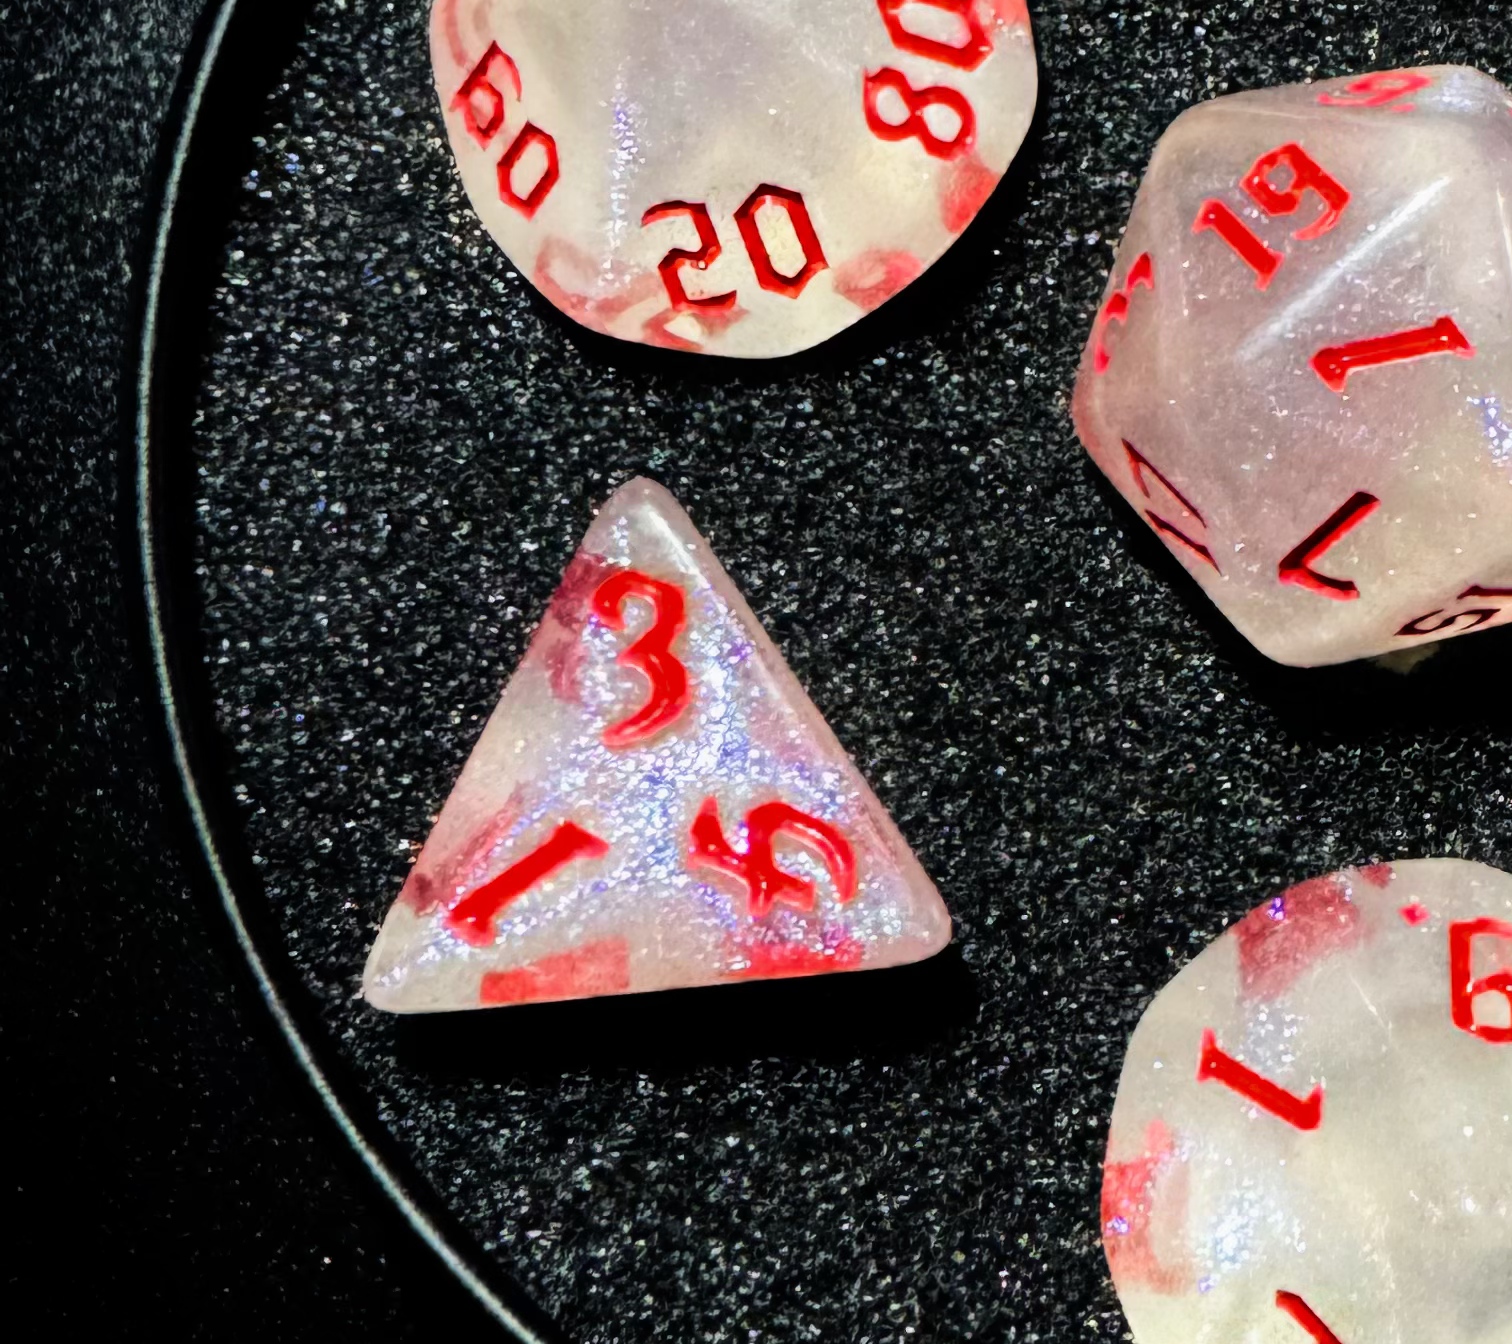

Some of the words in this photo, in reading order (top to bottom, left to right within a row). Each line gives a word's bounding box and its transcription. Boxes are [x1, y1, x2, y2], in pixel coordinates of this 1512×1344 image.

[448, 38, 562, 222] 60
[640, 180, 832, 316] 20
[1190, 140, 1352, 292] 19
[1308, 314, 1478, 394] 1
[1276, 488, 1384, 602] 7
[590, 568, 692, 752] 3
[446, 818, 614, 946] 1
[1194, 1026, 1326, 1134] 1
